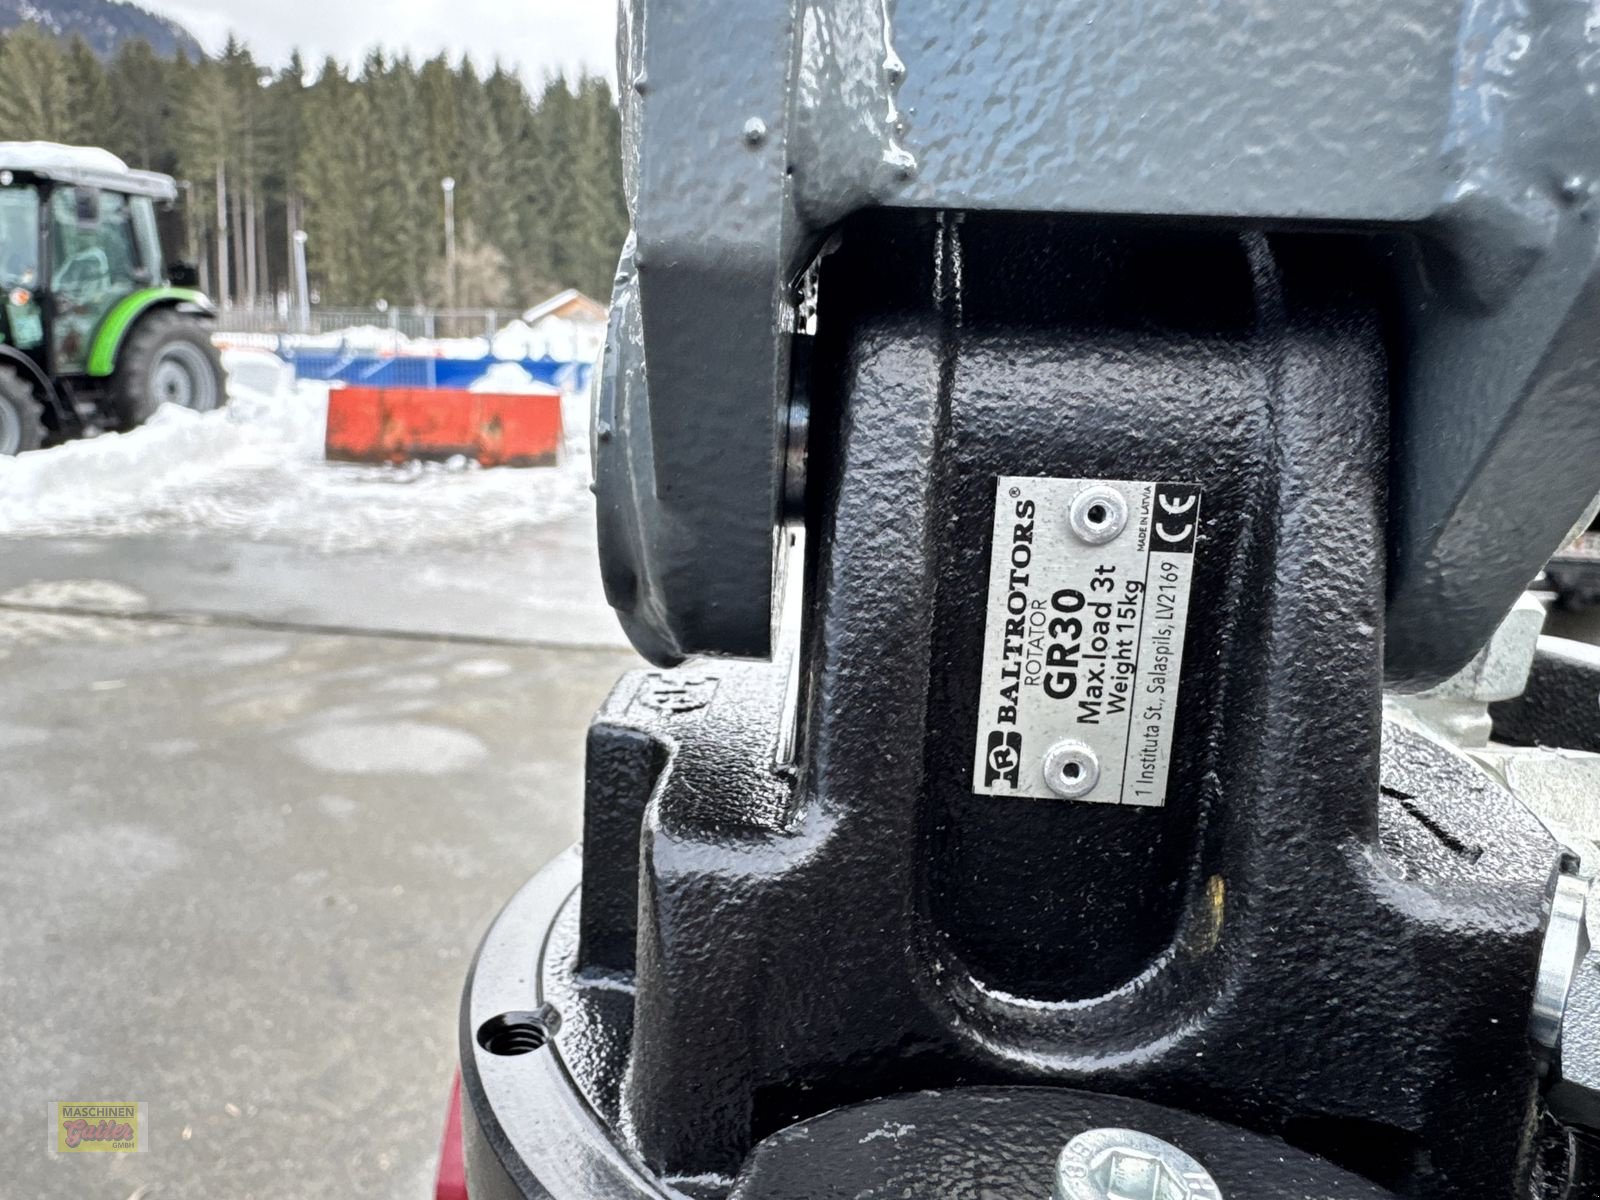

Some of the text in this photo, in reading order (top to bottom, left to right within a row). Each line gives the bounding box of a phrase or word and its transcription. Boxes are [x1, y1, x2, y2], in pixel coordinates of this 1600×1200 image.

[1137, 527, 1147, 552] MADE
[1142, 486, 1152, 515] LATVIA
[1024, 599, 1048, 686] ROTATOR
[1043, 588, 1086, 700] GR30
[1077, 565, 1116, 725] Max.load 3t
[1107, 580, 1145, 714] Weight 15kg
[1136, 562, 1181, 796] 1 Instituta St., Salaspils, LV2169
